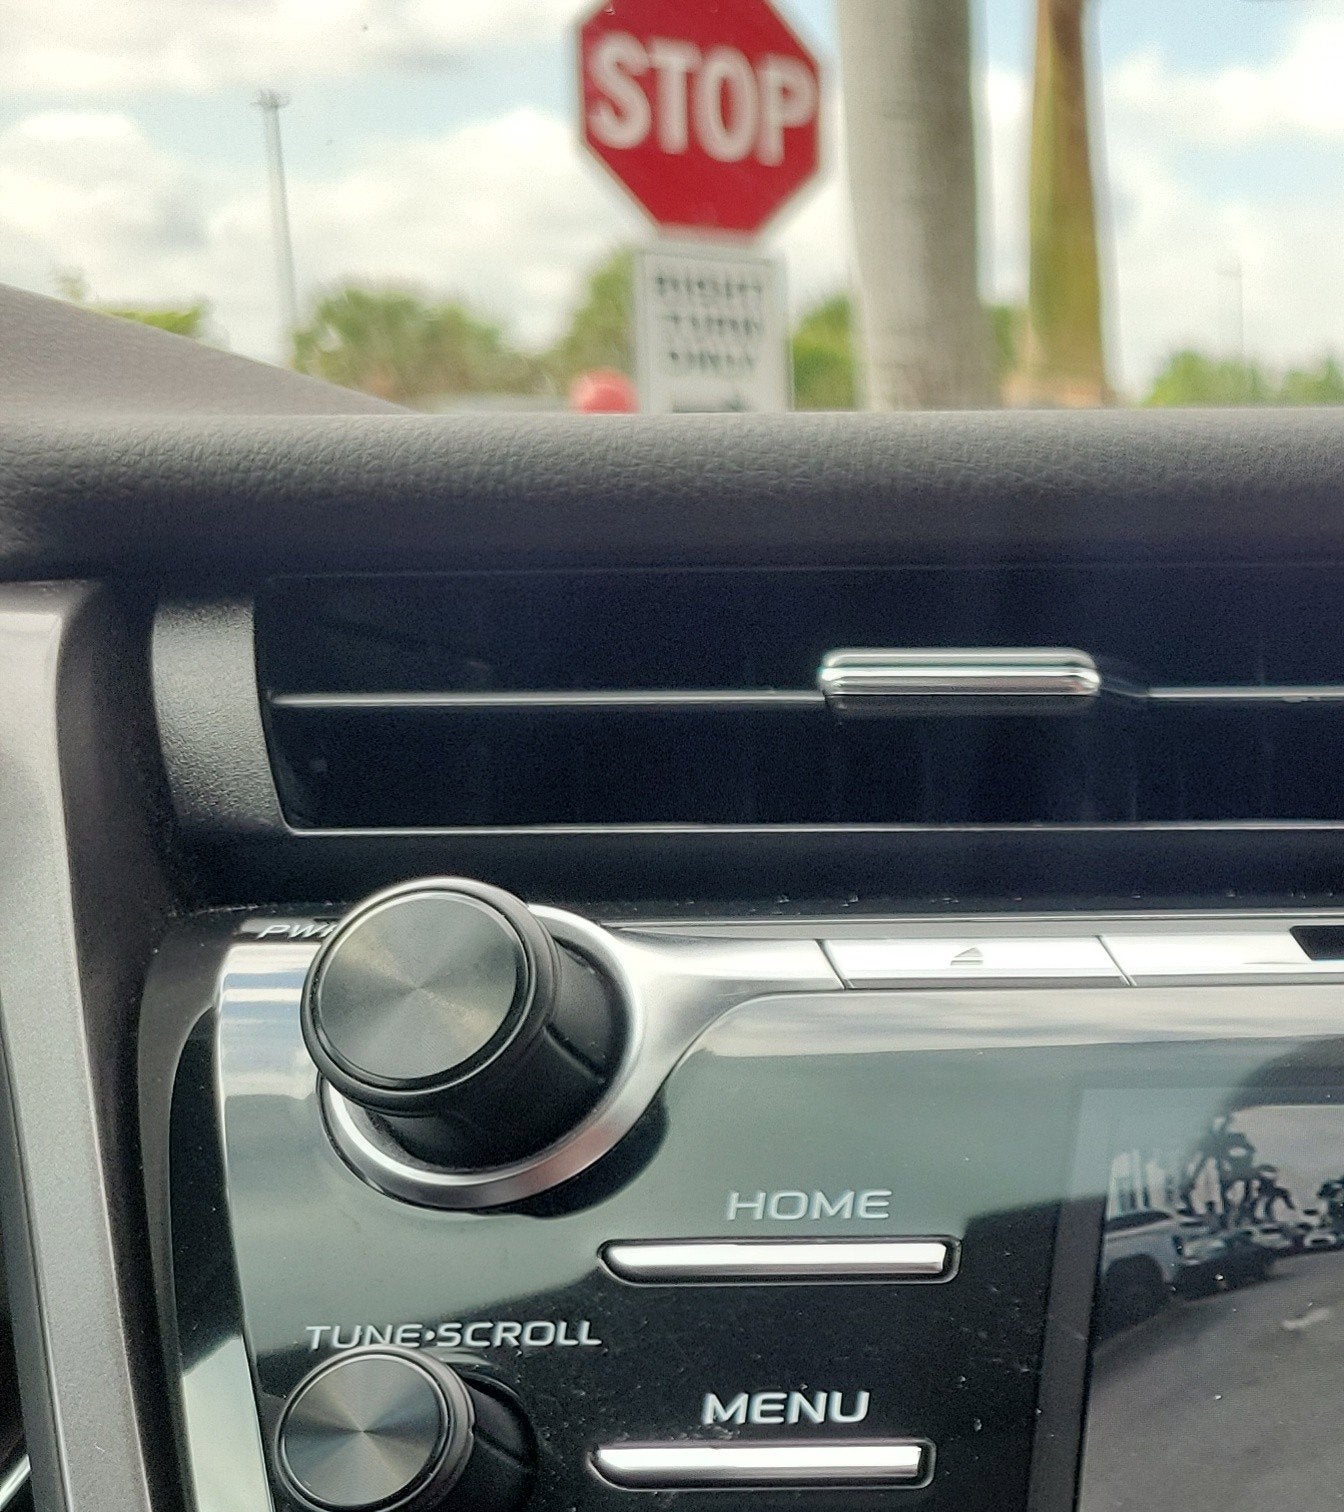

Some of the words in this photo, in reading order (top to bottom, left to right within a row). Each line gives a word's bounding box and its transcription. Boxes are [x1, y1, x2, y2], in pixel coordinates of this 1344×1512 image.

[588, 34, 816, 166] STOP
[725, 1190, 894, 1222] HOME
[700, 1391, 870, 1425] MENU
